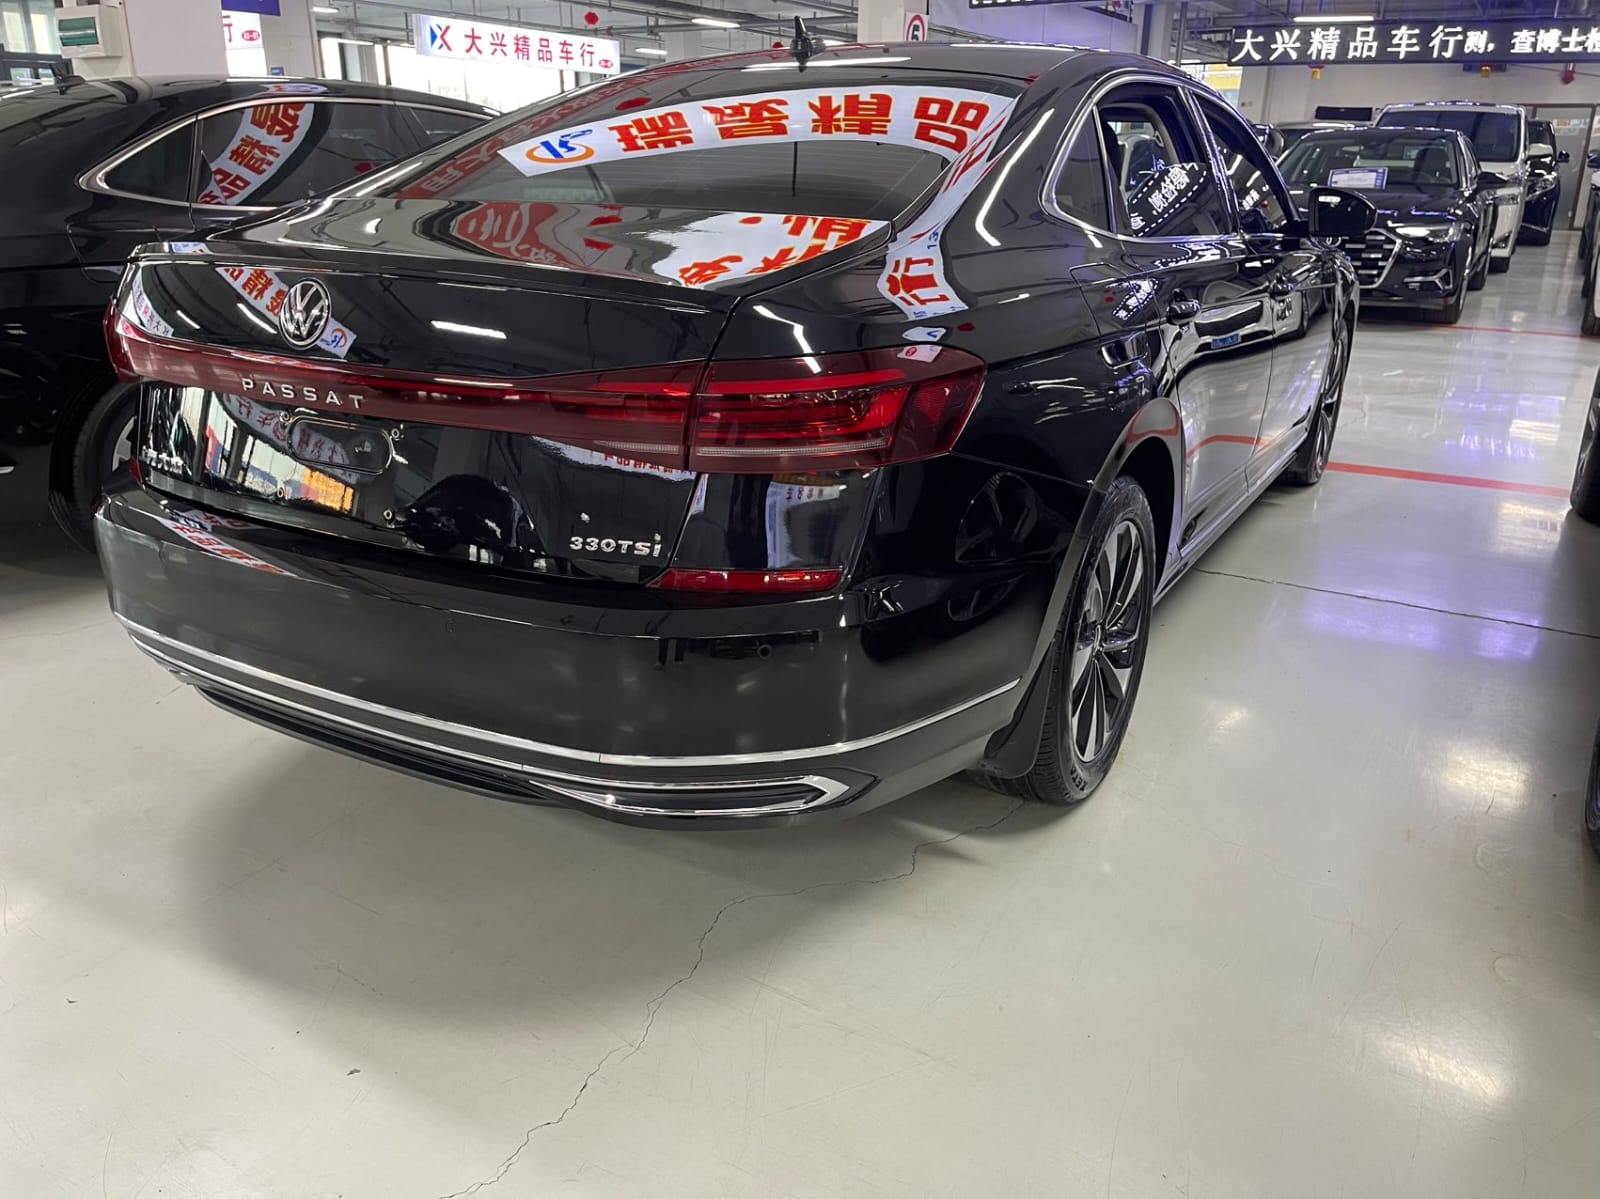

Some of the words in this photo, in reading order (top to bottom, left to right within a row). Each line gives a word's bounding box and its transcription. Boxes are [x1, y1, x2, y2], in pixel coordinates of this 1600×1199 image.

[464, 27, 595, 68] 大兴精品车行
[241, 377, 364, 409] PASSAT
